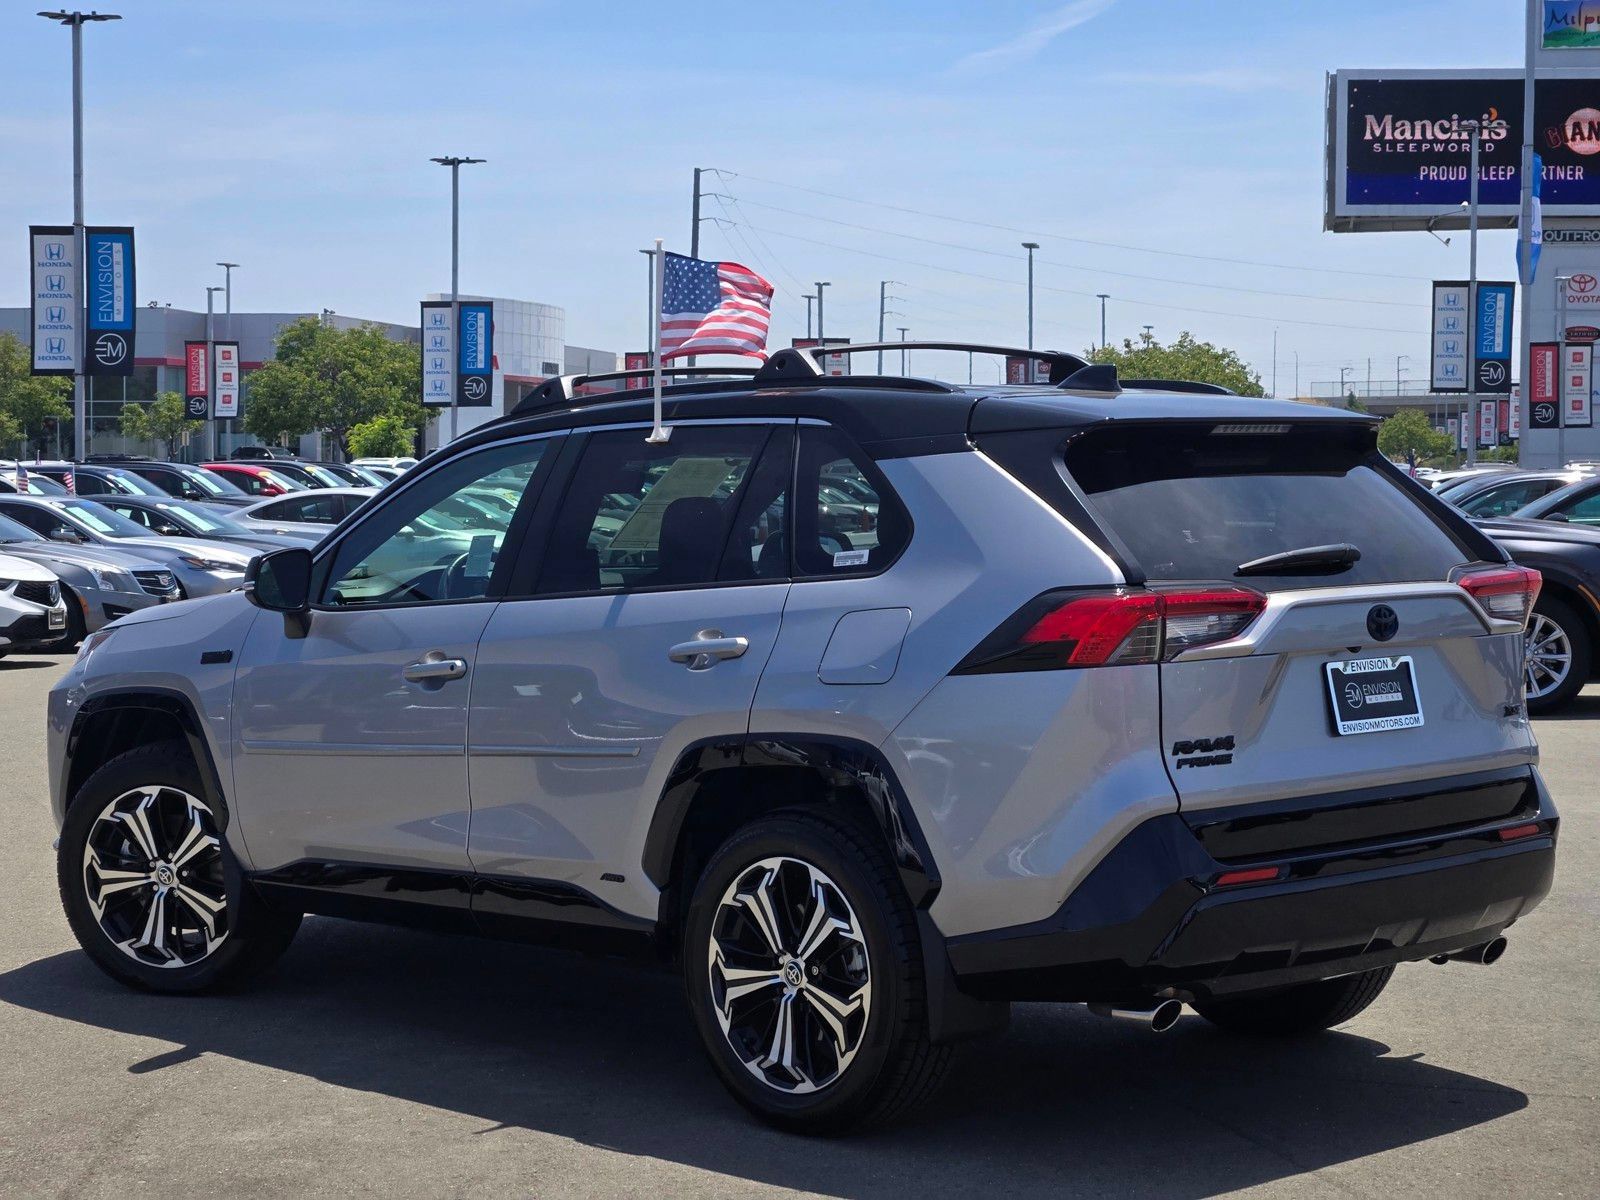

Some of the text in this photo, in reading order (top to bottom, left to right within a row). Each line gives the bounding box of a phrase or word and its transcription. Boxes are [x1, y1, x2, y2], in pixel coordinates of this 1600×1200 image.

[1373, 143, 1495, 152] SLEEPWORD
[1419, 166, 1467, 181] PROUD
[1540, 166, 1584, 181] RTNER
[98, 242, 113, 322] ENVISION
[1567, 295, 1600, 304] OYOTA
[1483, 292, 1497, 353] ENVISION
[466, 312, 477, 369] ENVISION
[191, 348, 200, 392] ENVISION
[1536, 350, 1546, 398] ENVISION
[1350, 659, 1388, 672] ENVISION
[1362, 681, 1402, 696] ENVISION
[1342, 716, 1421, 733] ENVISIONMOTORS.COM
[1172, 735, 1236, 756] RAV4
[1176, 753, 1234, 770] PRIME
